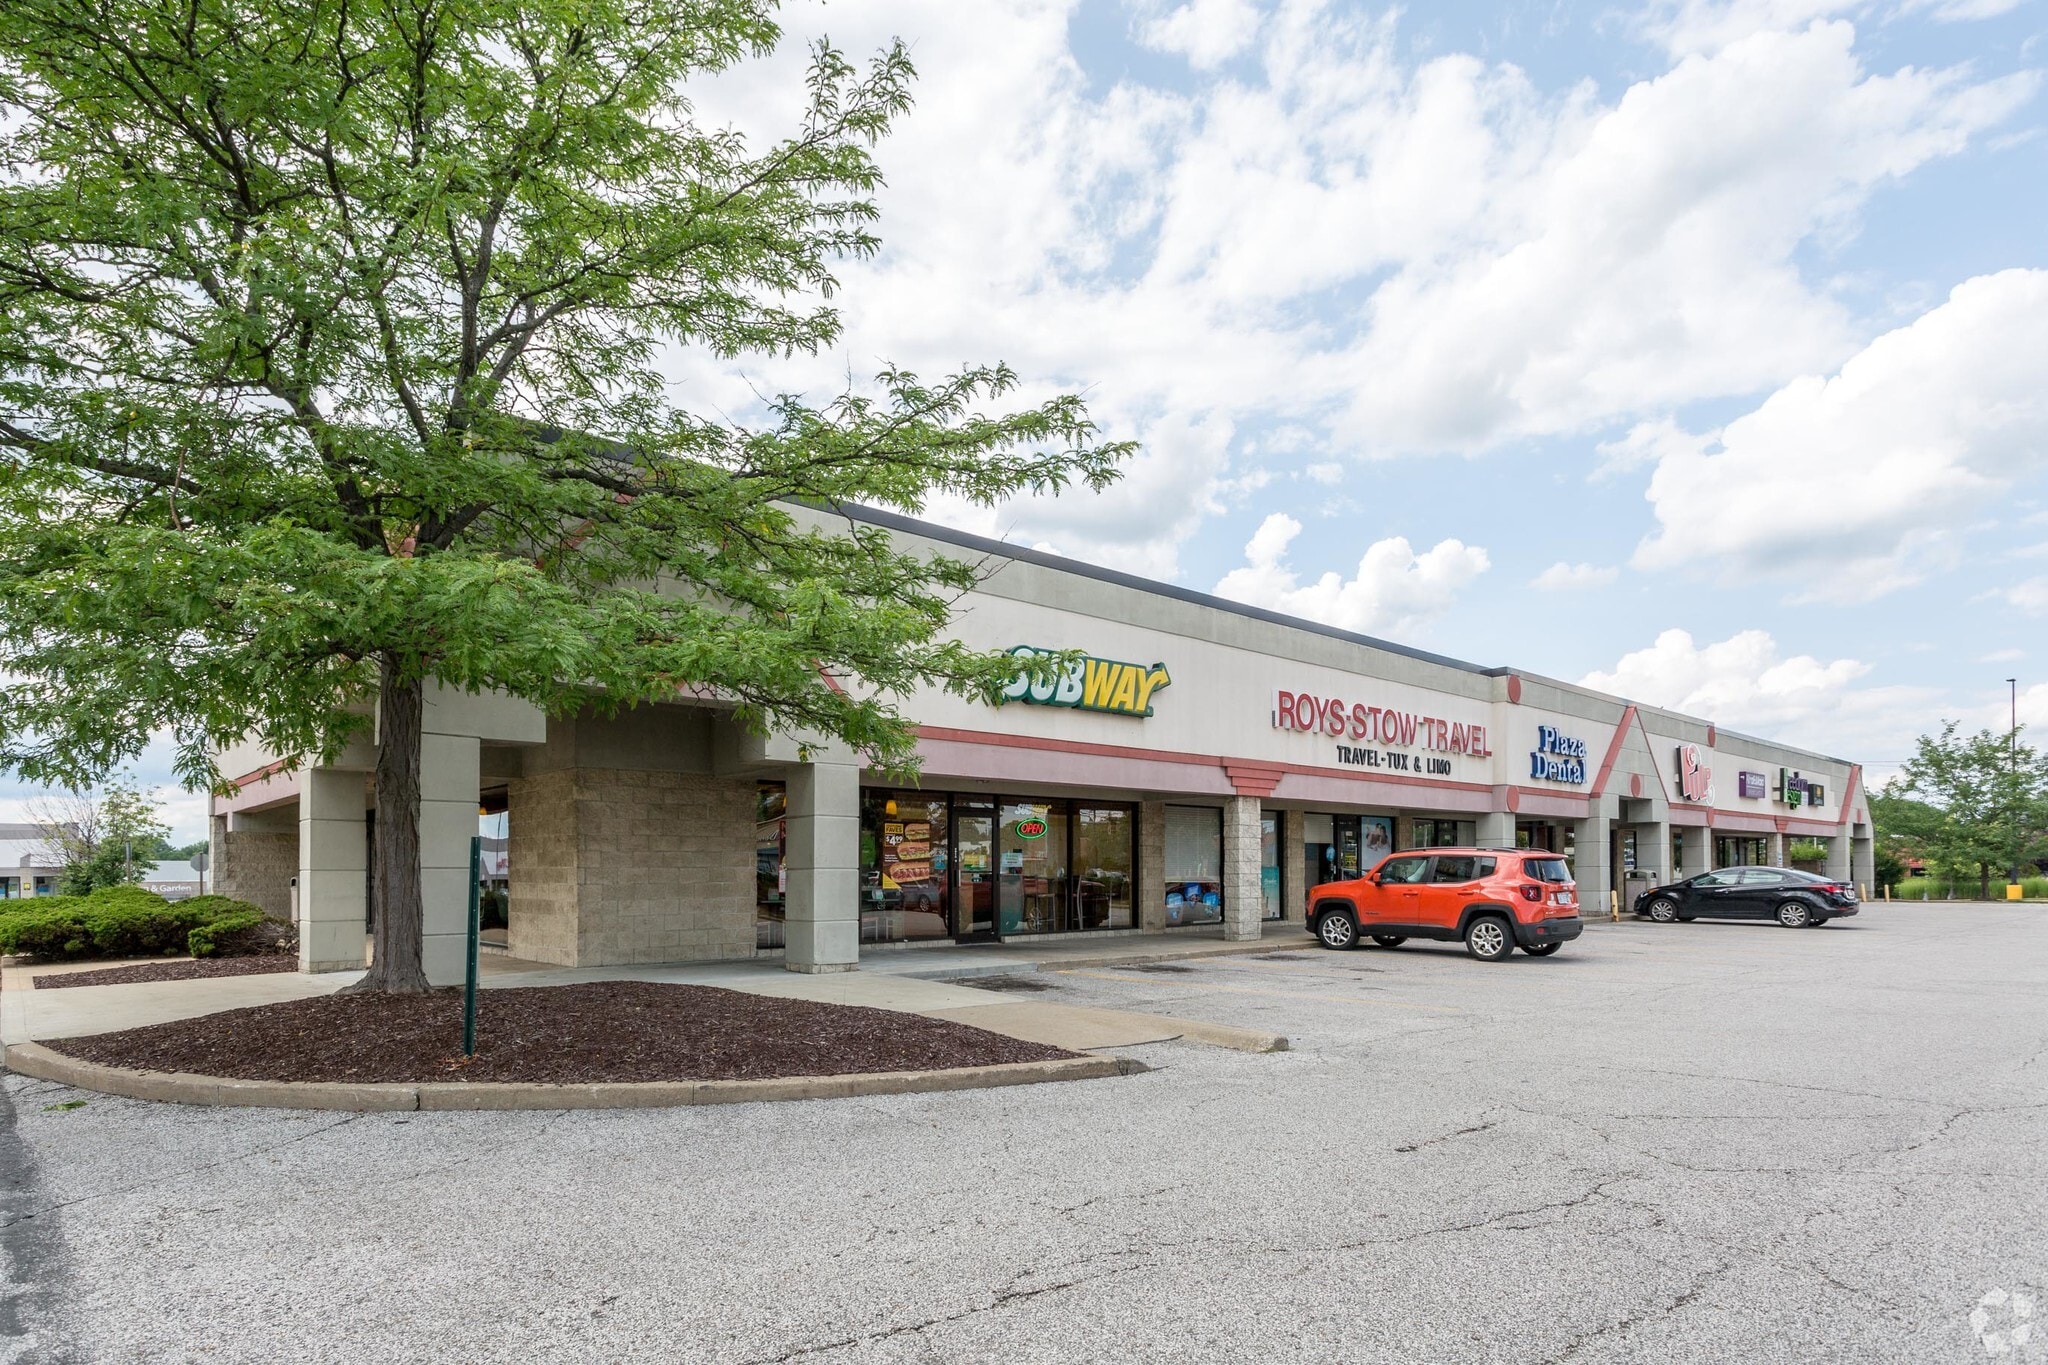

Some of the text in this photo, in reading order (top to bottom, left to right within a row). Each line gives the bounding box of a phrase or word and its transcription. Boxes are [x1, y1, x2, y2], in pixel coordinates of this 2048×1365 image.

[1002, 647, 1169, 712] SUBWAY
[1422, 716, 1493, 757] TRAVEL
[1538, 725, 1586, 758] Plaza
[1413, 755, 1422, 773] &
[1426, 757, 1451, 776] LIMO
[1530, 751, 1587, 784] Dental
[1021, 823, 1045, 834] OPEN
[150, 884, 158, 892] &
[159, 884, 192, 892] Garden
